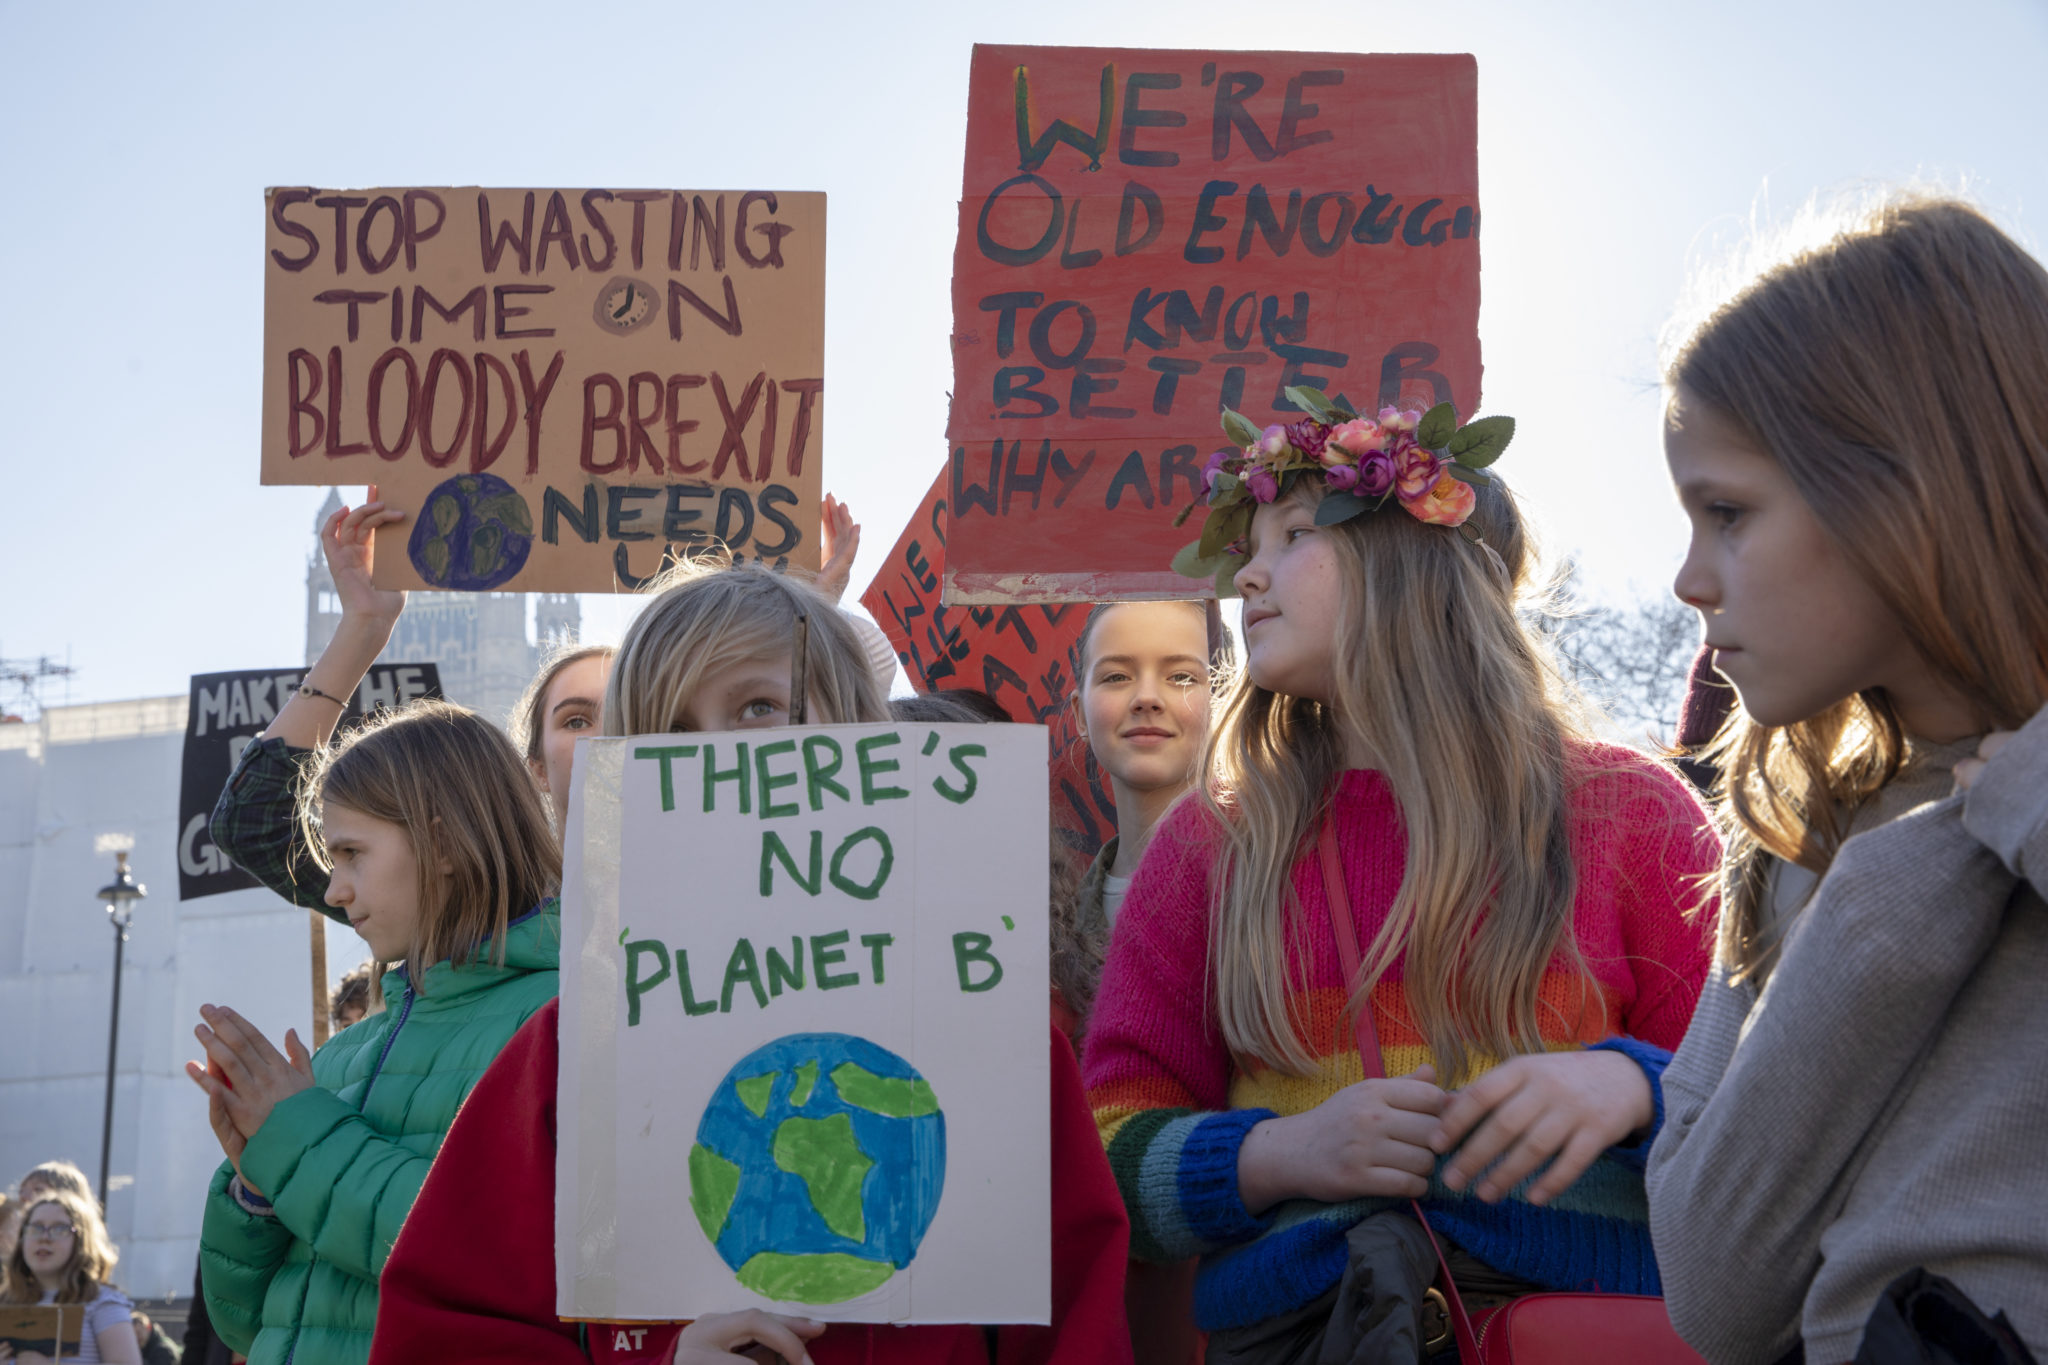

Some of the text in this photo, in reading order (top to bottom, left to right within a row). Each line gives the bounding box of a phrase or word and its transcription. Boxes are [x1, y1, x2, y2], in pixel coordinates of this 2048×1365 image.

[1013, 61, 1345, 172] WE'RE
[271, 187, 795, 276] STOP WASTING
[976, 174, 1165, 270] OLD
[313, 284, 557, 343] TIME
[978, 286, 1311, 371] TO KNOW
[286, 346, 825, 483] BLOODY BREXIT
[988, 341, 1461, 419] BETTER
[954, 437, 1242, 519] WHY AR
[541, 484, 803, 557] NEEDS
[195, 667, 426, 737] MAKE HE
[633, 730, 987, 820] THERE'S
[758, 825, 894, 900] NO
[612, 1328, 649, 1352] AT
